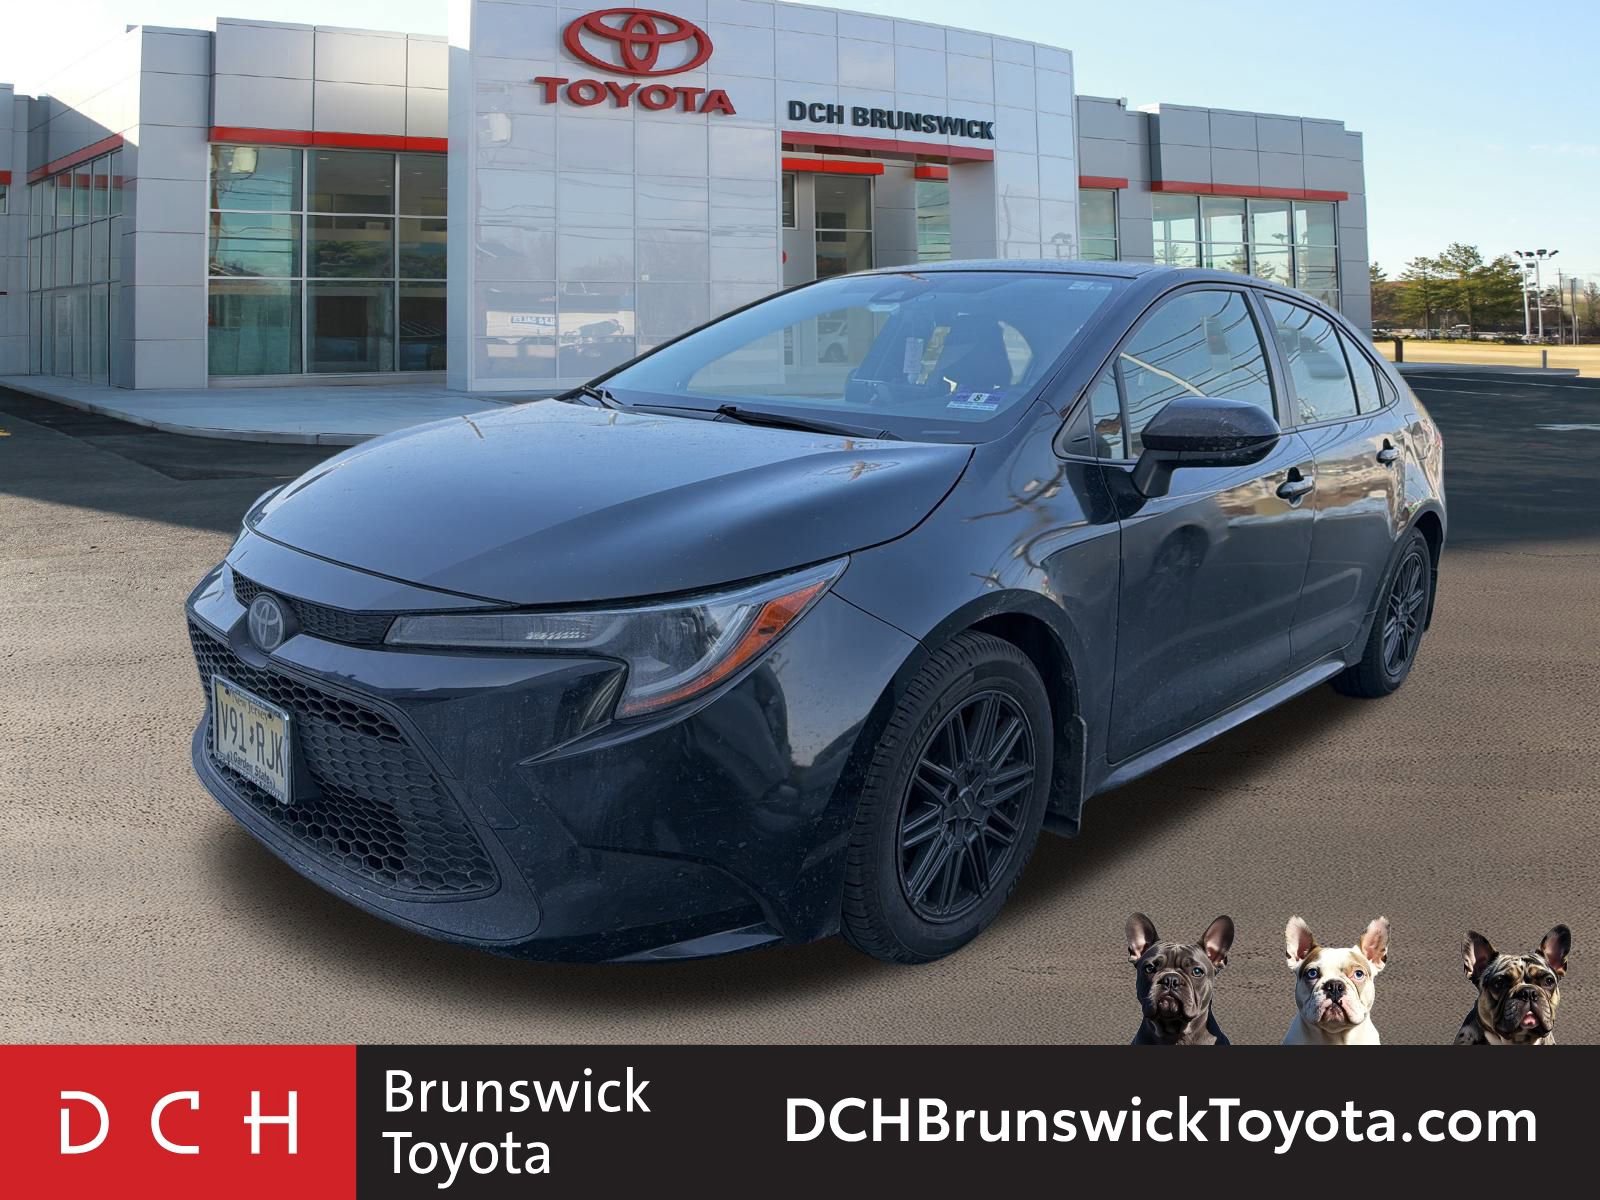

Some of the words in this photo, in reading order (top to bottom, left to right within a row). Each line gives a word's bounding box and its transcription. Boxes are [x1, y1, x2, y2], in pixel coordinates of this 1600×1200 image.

[534, 76, 736, 116] TOYOTA
[787, 100, 845, 125] DCH
[852, 105, 995, 140] BRUNSWICK
[221, 701, 247, 753] V91
[256, 721, 284, 777] RJK
[233, 751, 253, 771] Garden
[254, 765, 271, 783] State
